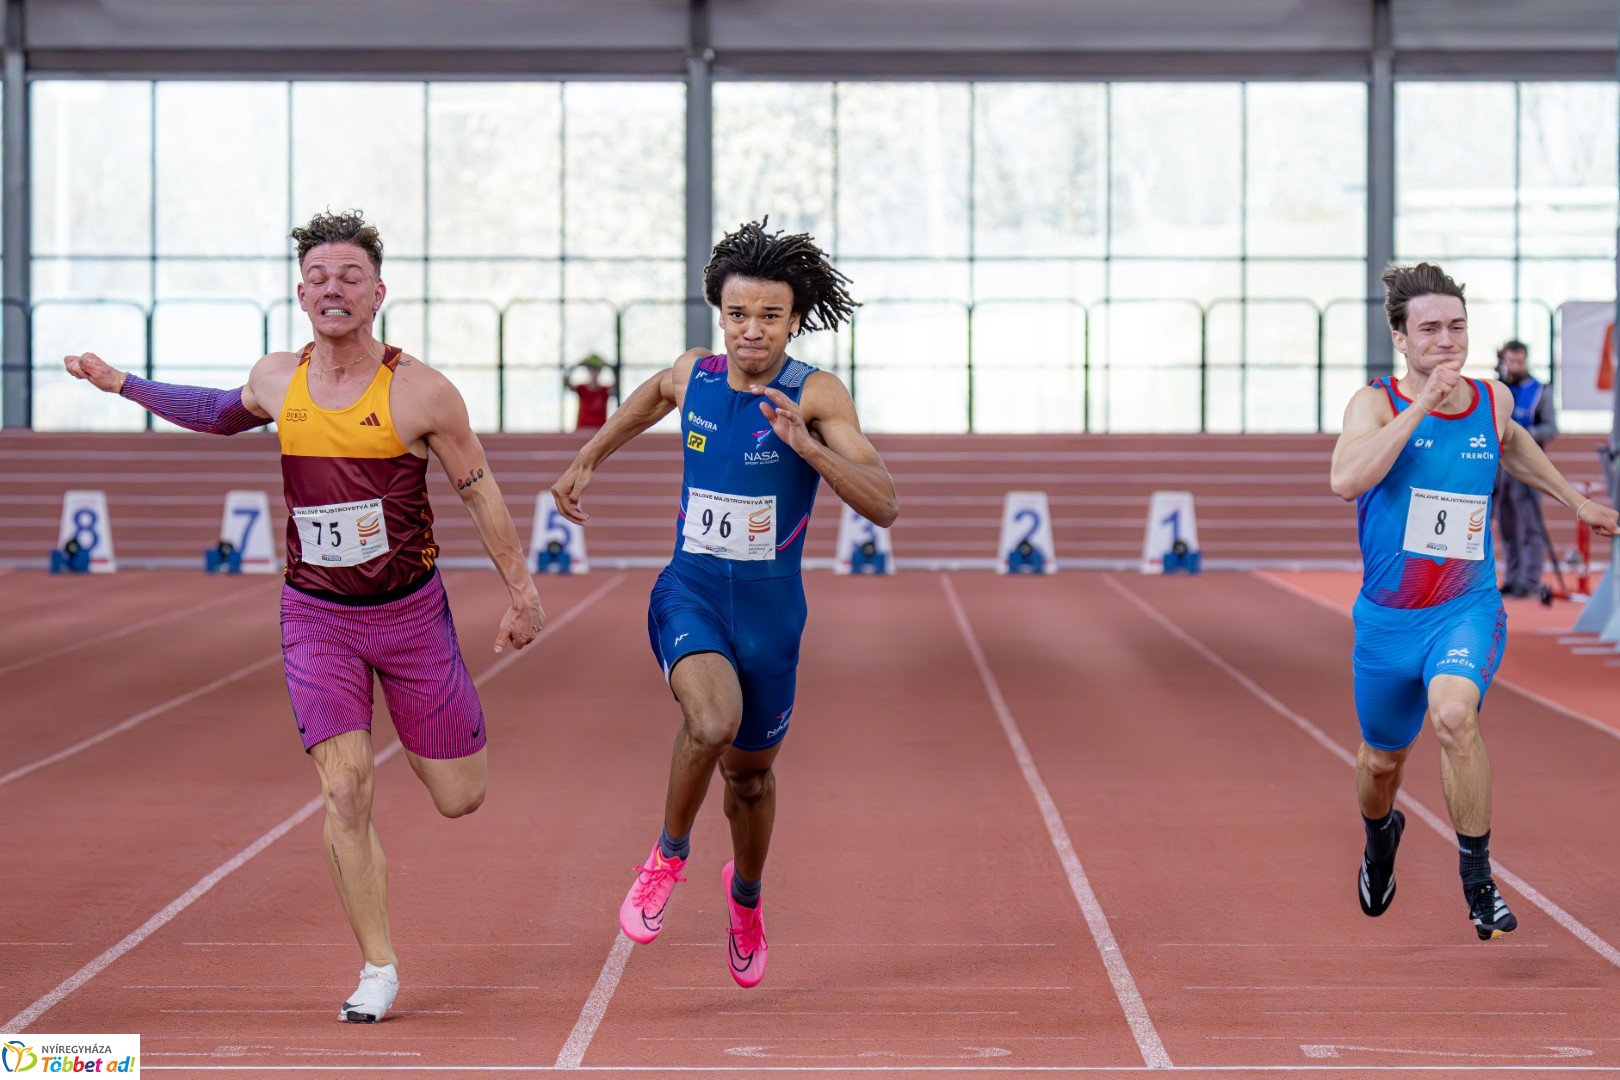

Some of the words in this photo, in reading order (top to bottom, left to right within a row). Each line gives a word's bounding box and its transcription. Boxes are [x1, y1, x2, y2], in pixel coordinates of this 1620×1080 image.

[744, 450, 780, 461] NASA
[73, 508, 99, 551] 8
[231, 508, 261, 553] 7
[311, 521, 342, 548] 75
[546, 508, 572, 551] 5
[701, 508, 732, 539] 96
[1014, 508, 1041, 548] 2
[1161, 508, 1181, 548] 1
[1434, 509, 1448, 536] 8
